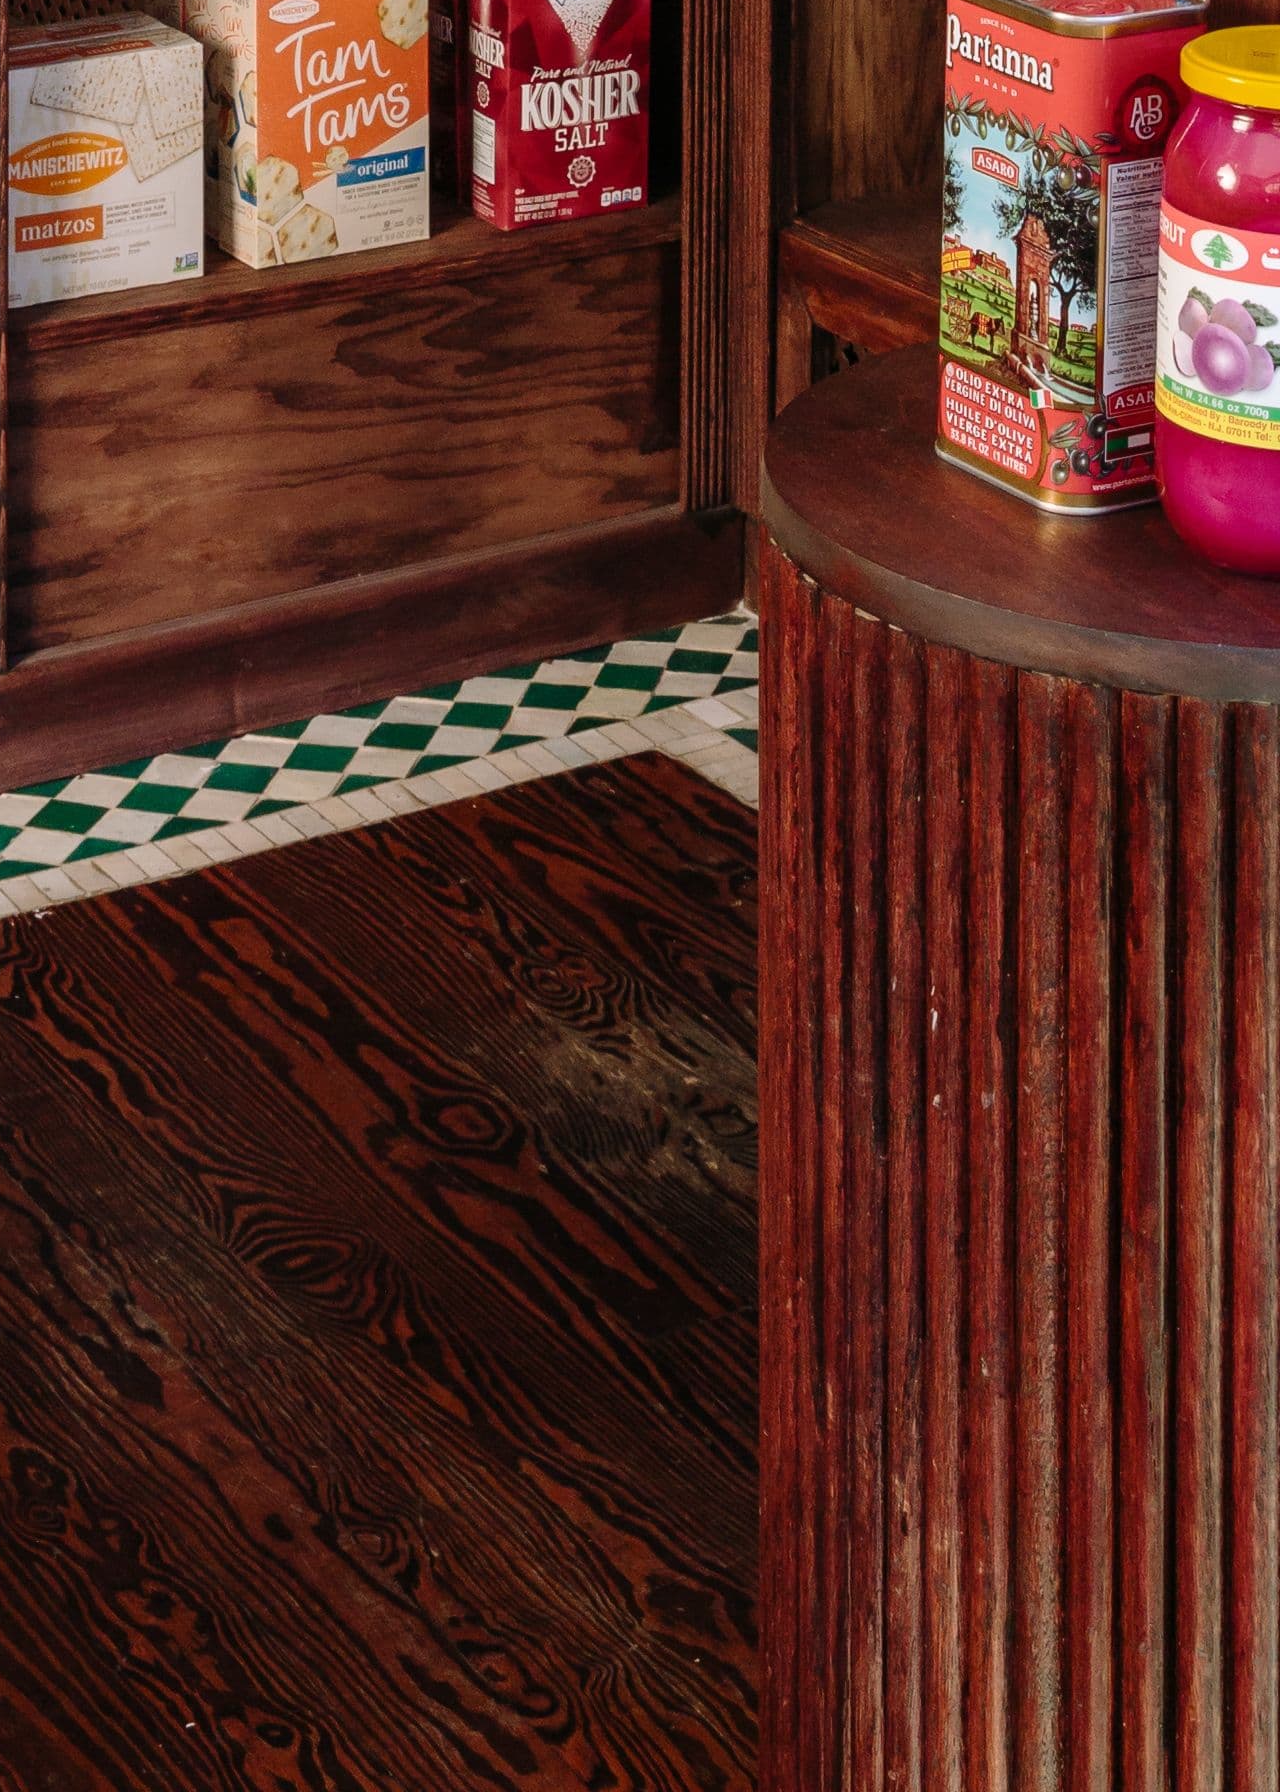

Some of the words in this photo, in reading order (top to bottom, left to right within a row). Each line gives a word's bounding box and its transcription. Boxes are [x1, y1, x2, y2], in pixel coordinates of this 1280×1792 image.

[275, 21, 391, 94] Tam
[530, 66, 561, 83] Pure
[562, 61, 587, 77] and
[588, 53, 633, 75] Natural
[520, 69, 641, 132] KOSHER
[974, 74, 1018, 98] BRAND
[286, 79, 411, 154] Tams
[554, 121, 609, 153] SALT
[7, 147, 124, 182] MANISCHEWITZ
[357, 153, 408, 177] original
[975, 153, 1015, 180] ASARO
[21, 216, 96, 243] matzos
[944, 375, 986, 407] VERGINE
[989, 397, 1001, 413] DI
[1004, 406, 1037, 433] OLIVA
[956, 366, 983, 390] OLIO
[984, 381, 1025, 411] EXTRA
[945, 397, 982, 425] HUILE
[984, 416, 1034, 451] D'OLIVE
[1227, 401, 1240, 413] oz
[1244, 403, 1270, 421] 700g
[1228, 414, 1268, 433] Baroody
[945, 411, 988, 442] VIERGE
[991, 433, 1033, 466] EXTRA
[1225, 425, 1254, 439] 07011
[1002, 454, 1028, 477] LITRE)
